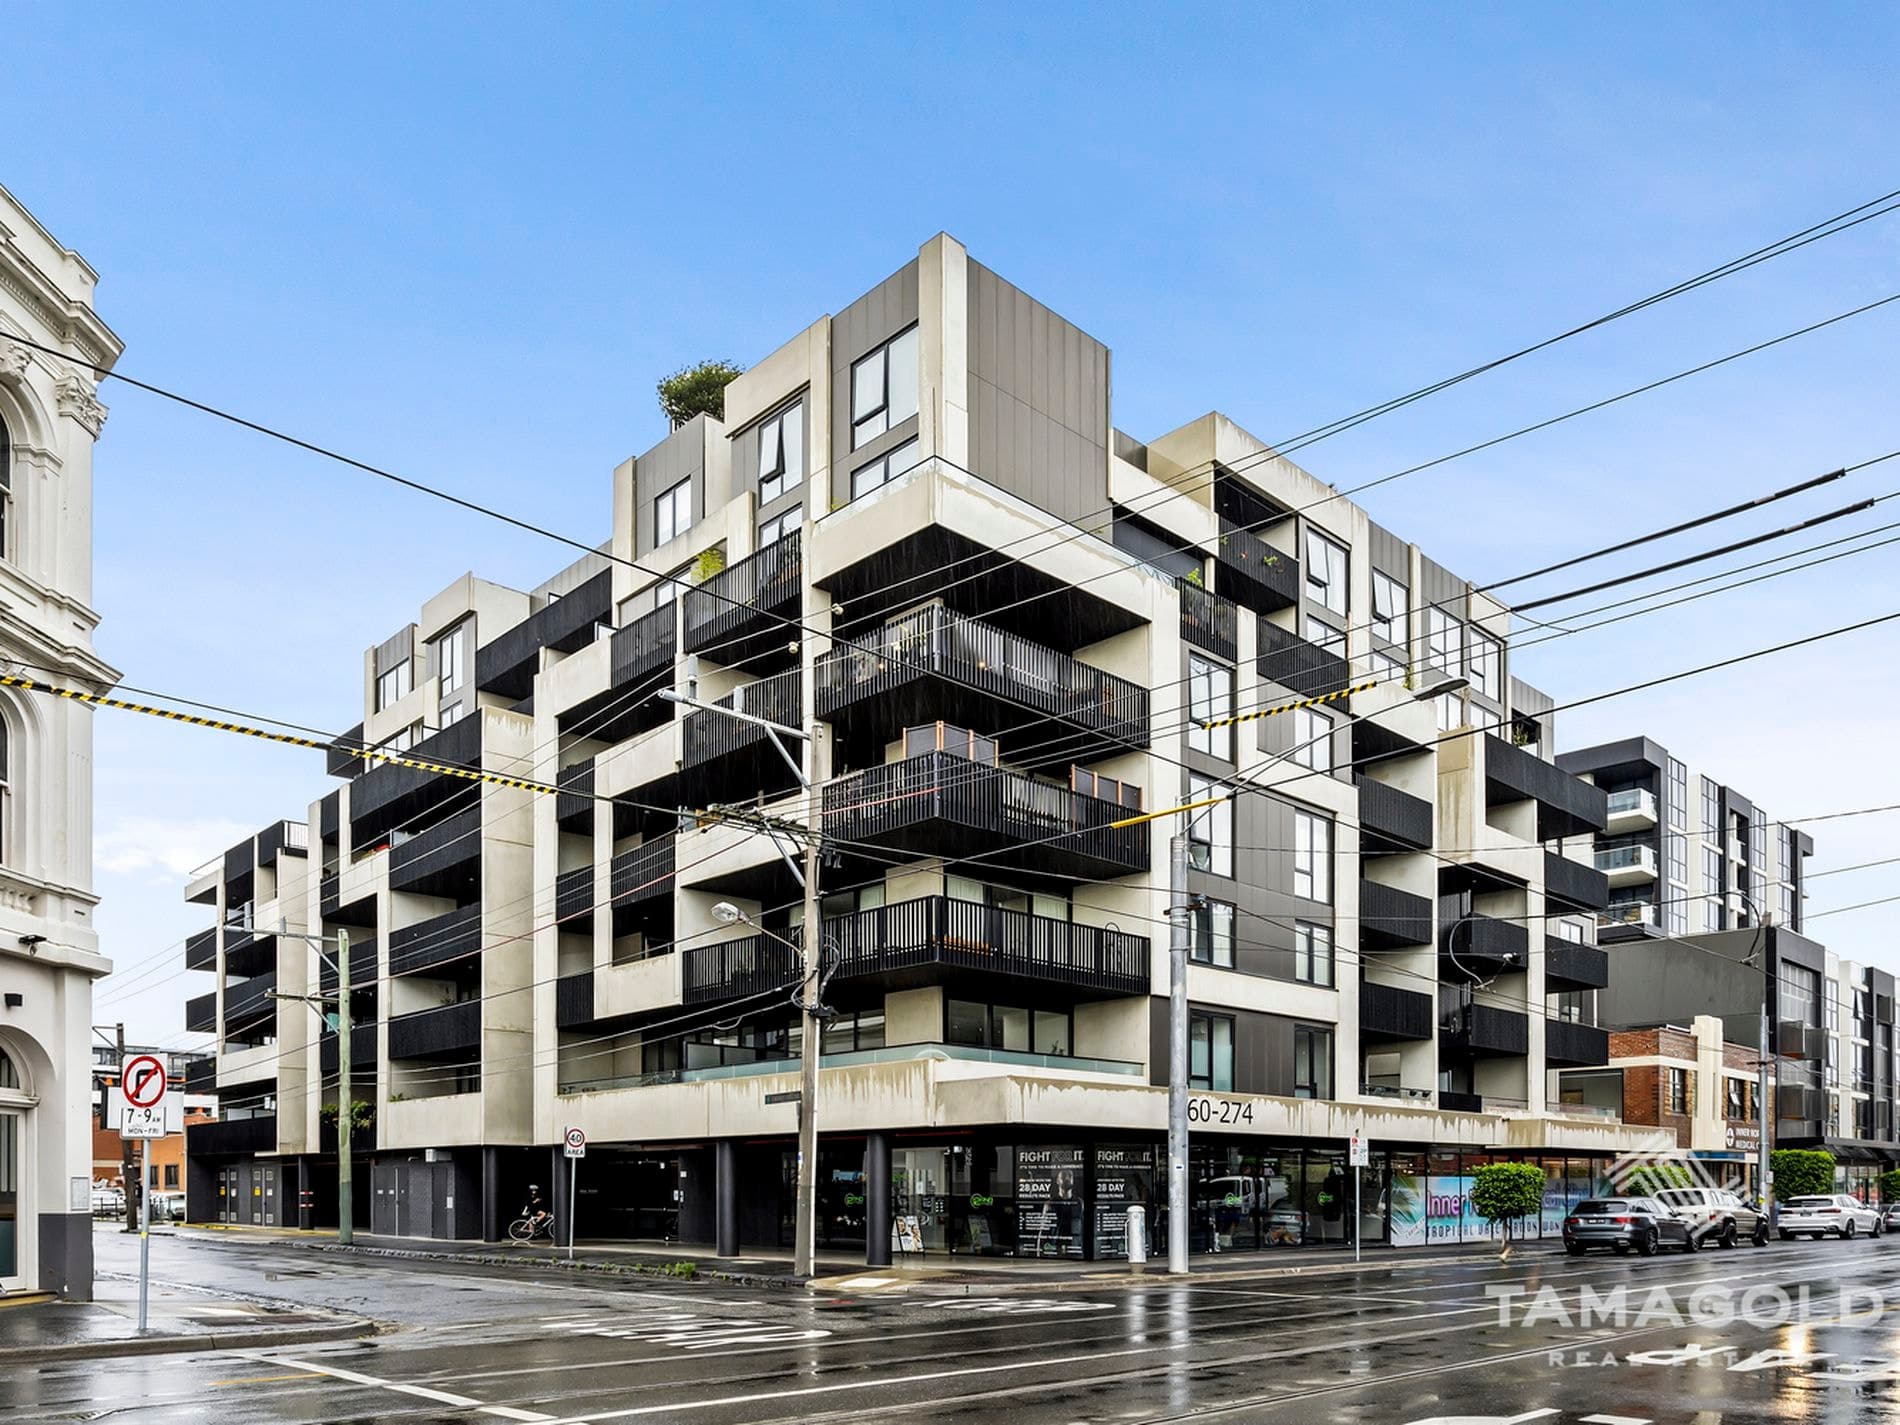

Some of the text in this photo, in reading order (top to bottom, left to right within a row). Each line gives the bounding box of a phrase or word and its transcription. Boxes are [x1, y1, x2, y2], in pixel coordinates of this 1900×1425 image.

[570, 1133, 582, 1143] 40
[1735, 1140, 1756, 1150] MEDICAL
[1019, 1151, 1051, 1162] FIGHT
[1097, 1150, 1124, 1161] FIGHT
[1018, 1183, 1051, 1192] 28 DAY
[1096, 1183, 1125, 1192] 28 DAY
[1427, 1190, 1467, 1217] Inner
